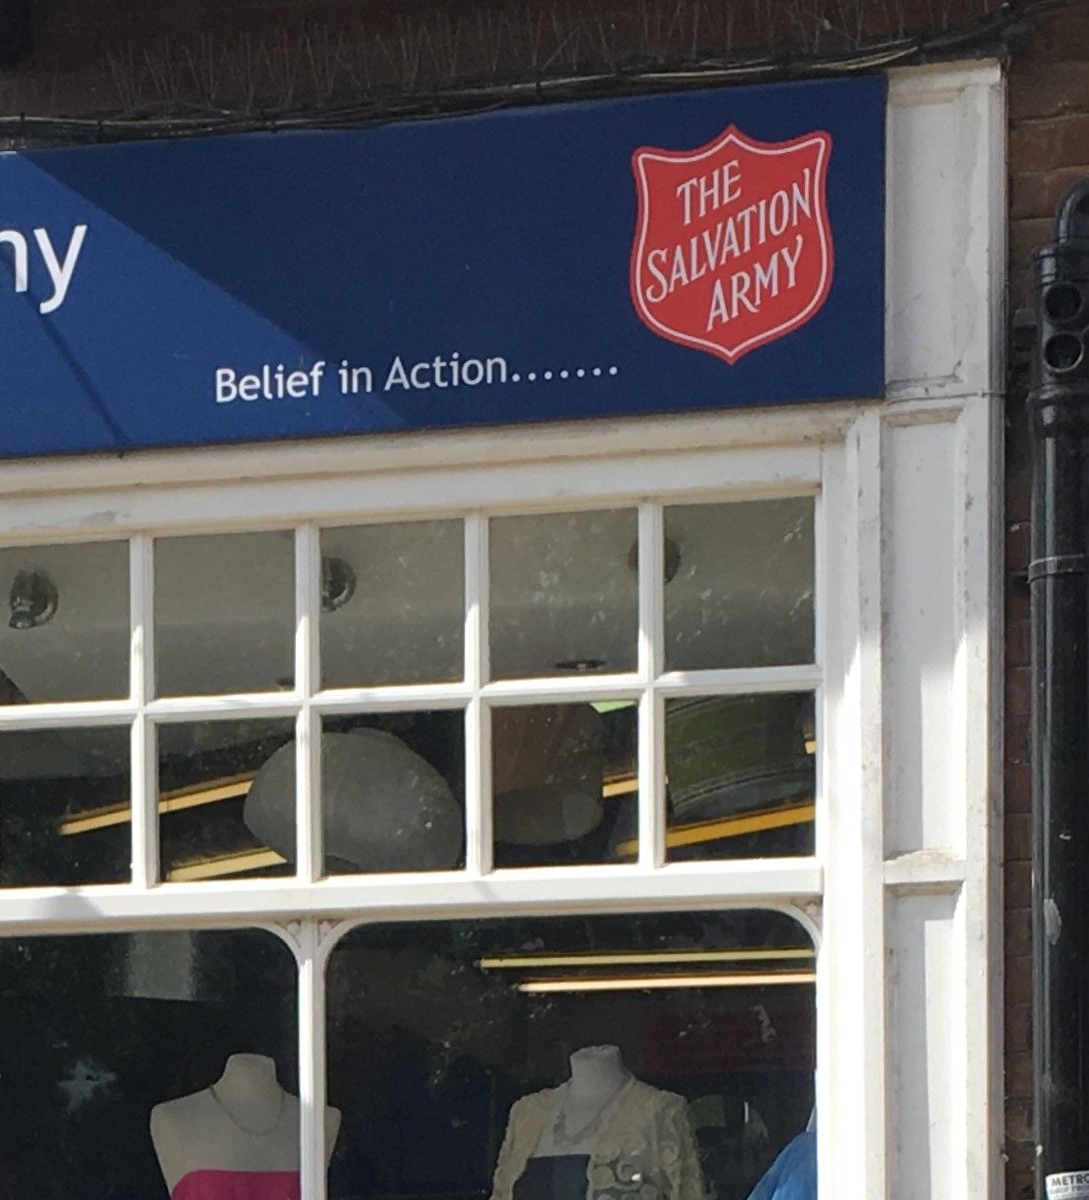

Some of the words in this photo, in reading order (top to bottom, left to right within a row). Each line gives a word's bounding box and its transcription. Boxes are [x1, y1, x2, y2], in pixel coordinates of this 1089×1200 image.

[645, 166, 812, 303] SALVATION
[676, 158, 742, 227] THE
[705, 233, 804, 332] ARMY
[214, 360, 326, 403] Belief
[338, 359, 372, 395] in
